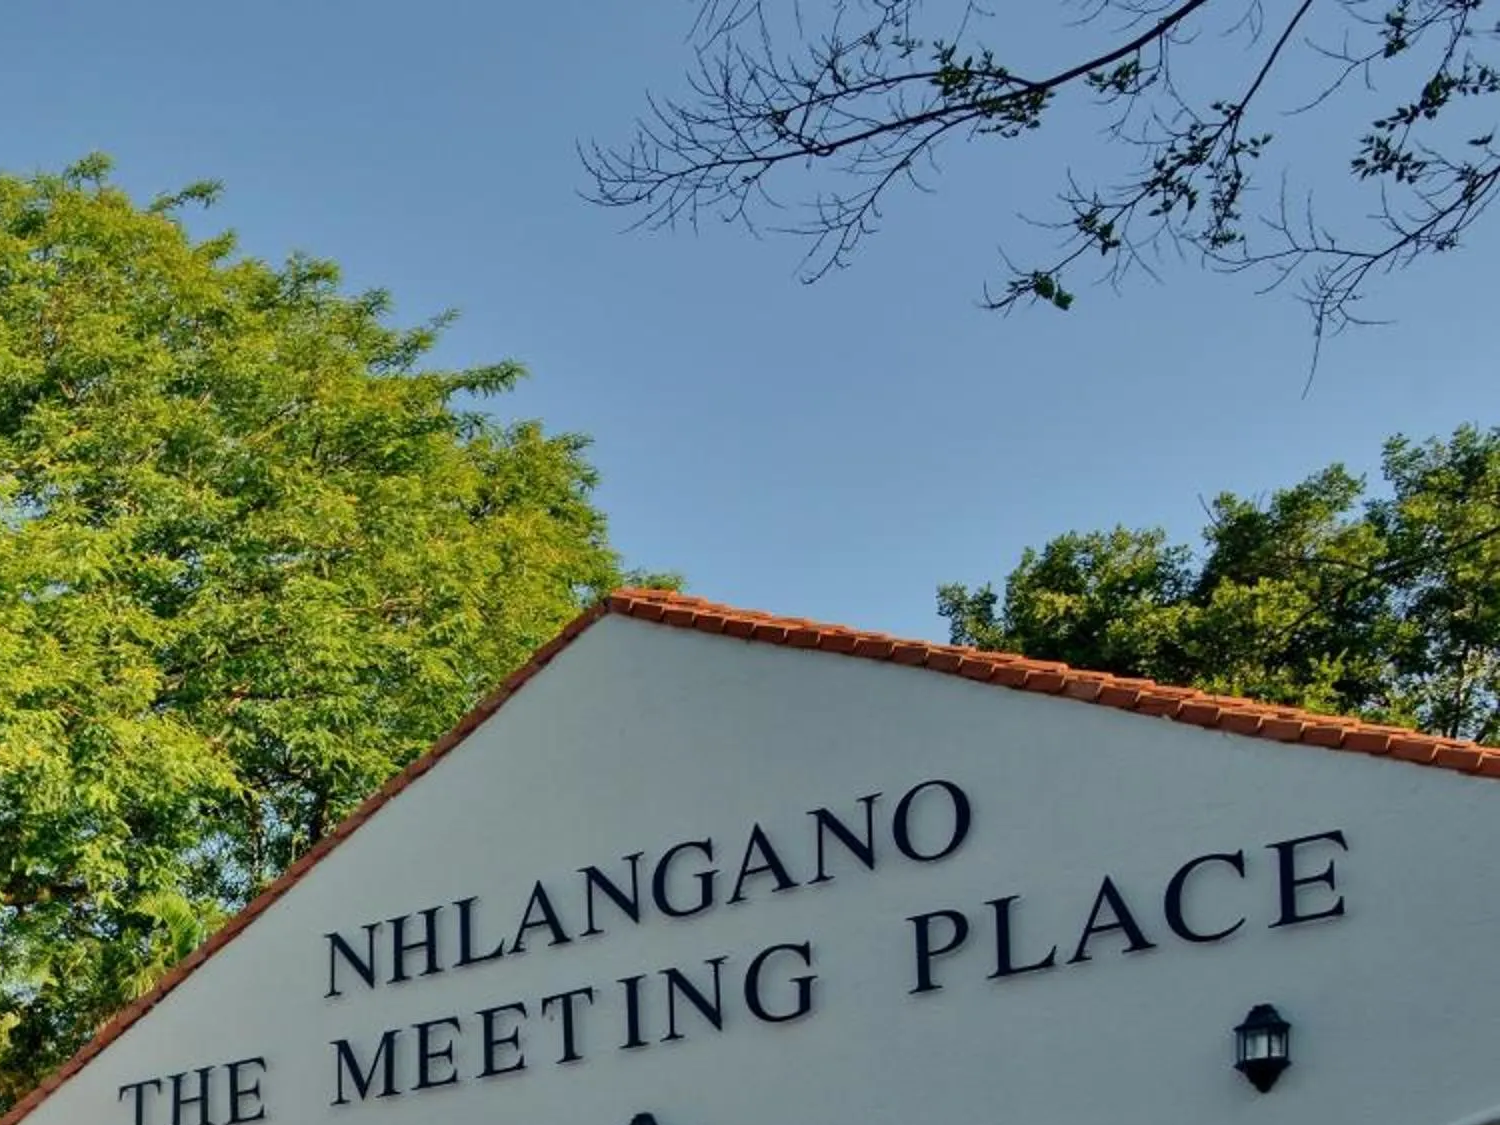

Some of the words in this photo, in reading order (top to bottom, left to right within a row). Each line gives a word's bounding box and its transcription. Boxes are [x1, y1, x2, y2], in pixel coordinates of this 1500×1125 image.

[321, 778, 979, 999] NHLANGANO
[329, 939, 821, 1107] MEETING
[904, 828, 1353, 1000] PLACE
